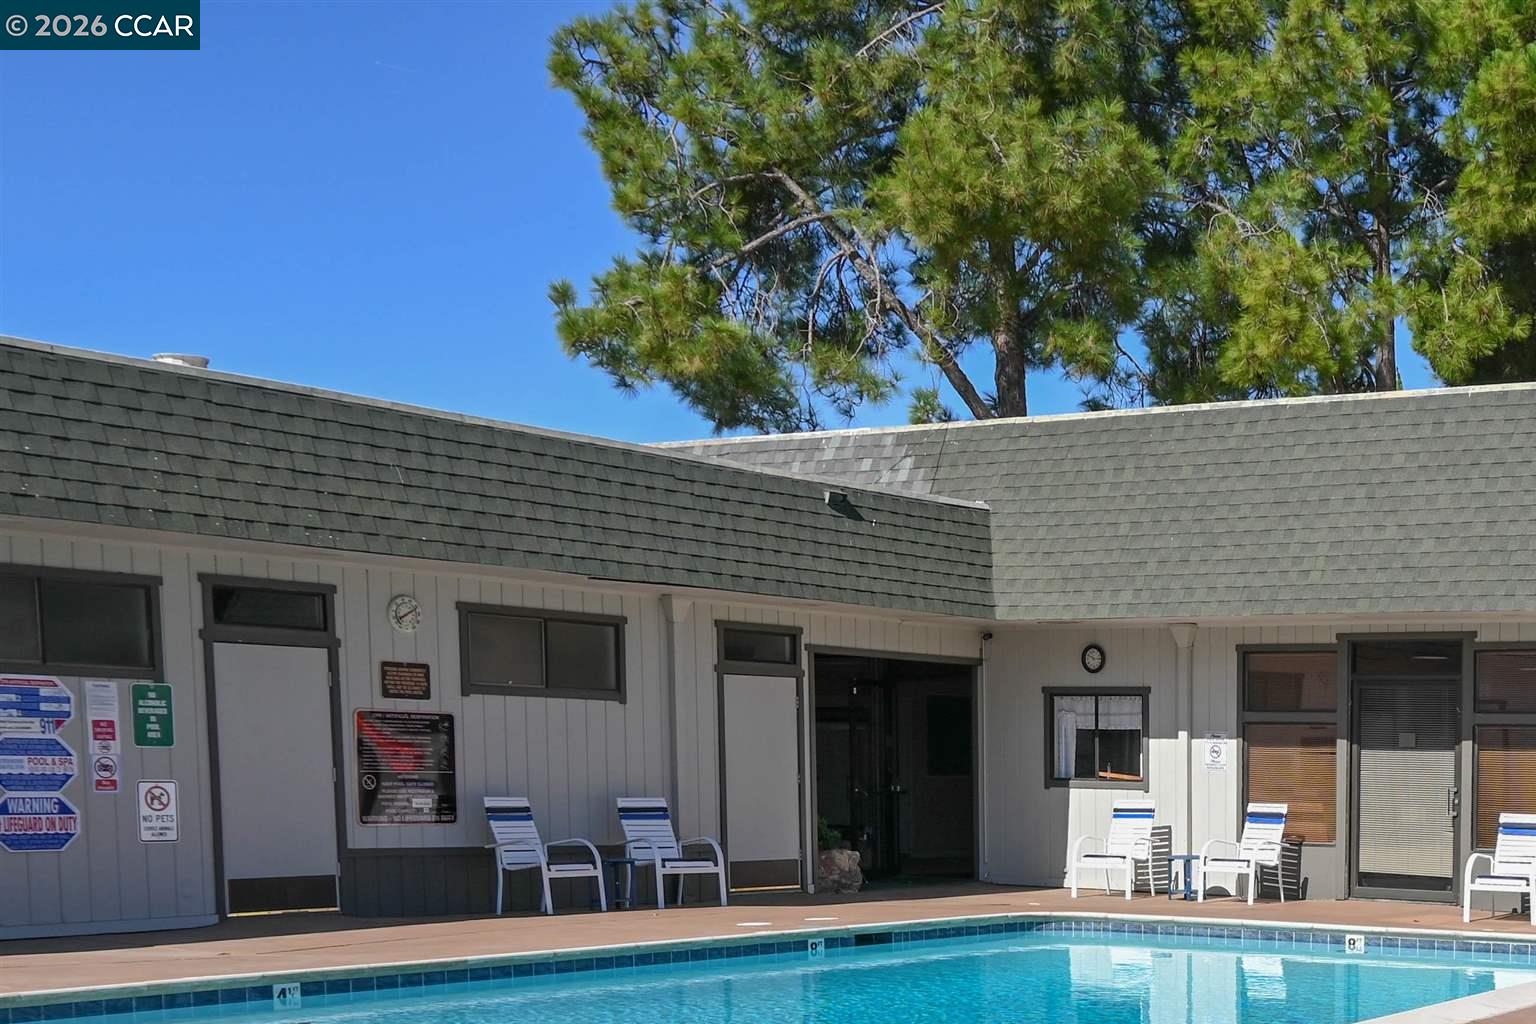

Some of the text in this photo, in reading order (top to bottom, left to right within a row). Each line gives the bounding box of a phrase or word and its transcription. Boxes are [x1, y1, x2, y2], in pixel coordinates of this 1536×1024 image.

[41, 718, 56, 734] 911
[27, 757, 50, 766] POOL
[51, 757, 57, 766] &
[58, 757, 74, 766] SPA
[7, 798, 59, 814] WARNING
[4, 816, 77, 832] LIFEGUARD ON DUTY
[142, 815, 175, 823] NO PETS
[1348, 938, 1356, 950] 8
